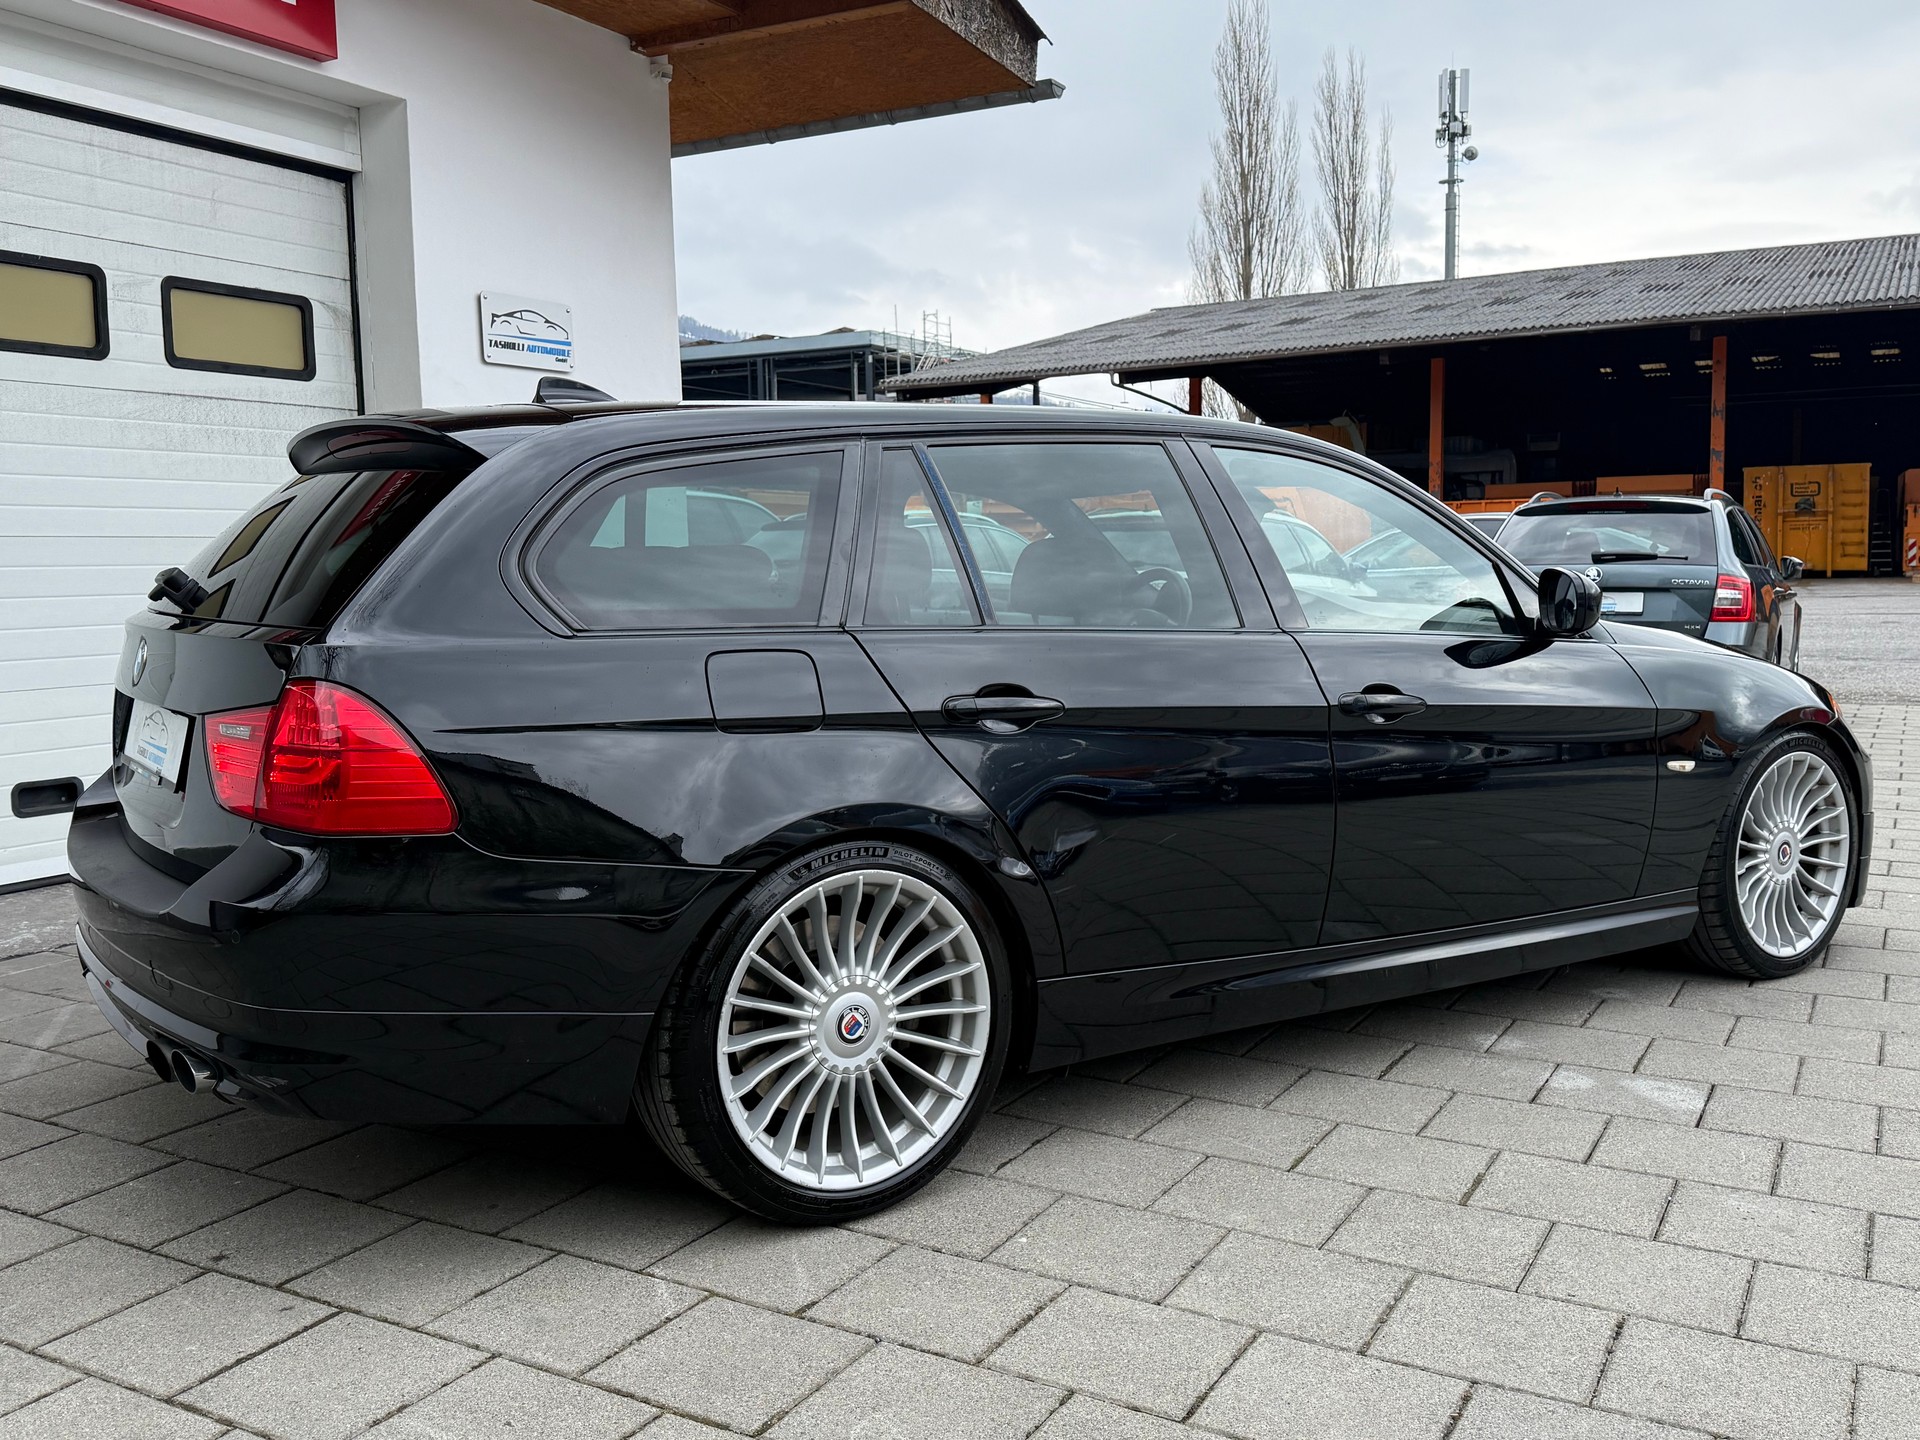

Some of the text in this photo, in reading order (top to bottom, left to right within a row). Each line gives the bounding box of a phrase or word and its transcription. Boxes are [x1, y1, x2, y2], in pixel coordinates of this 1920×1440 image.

[488, 339, 572, 358] TASHOLLI AUTOMOBILE
[1671, 578, 1710, 586] OCTAVIA
[810, 847, 886, 870] MICHELIN
[893, 849, 914, 859] PILOT
[914, 855, 936, 869] SPORT
